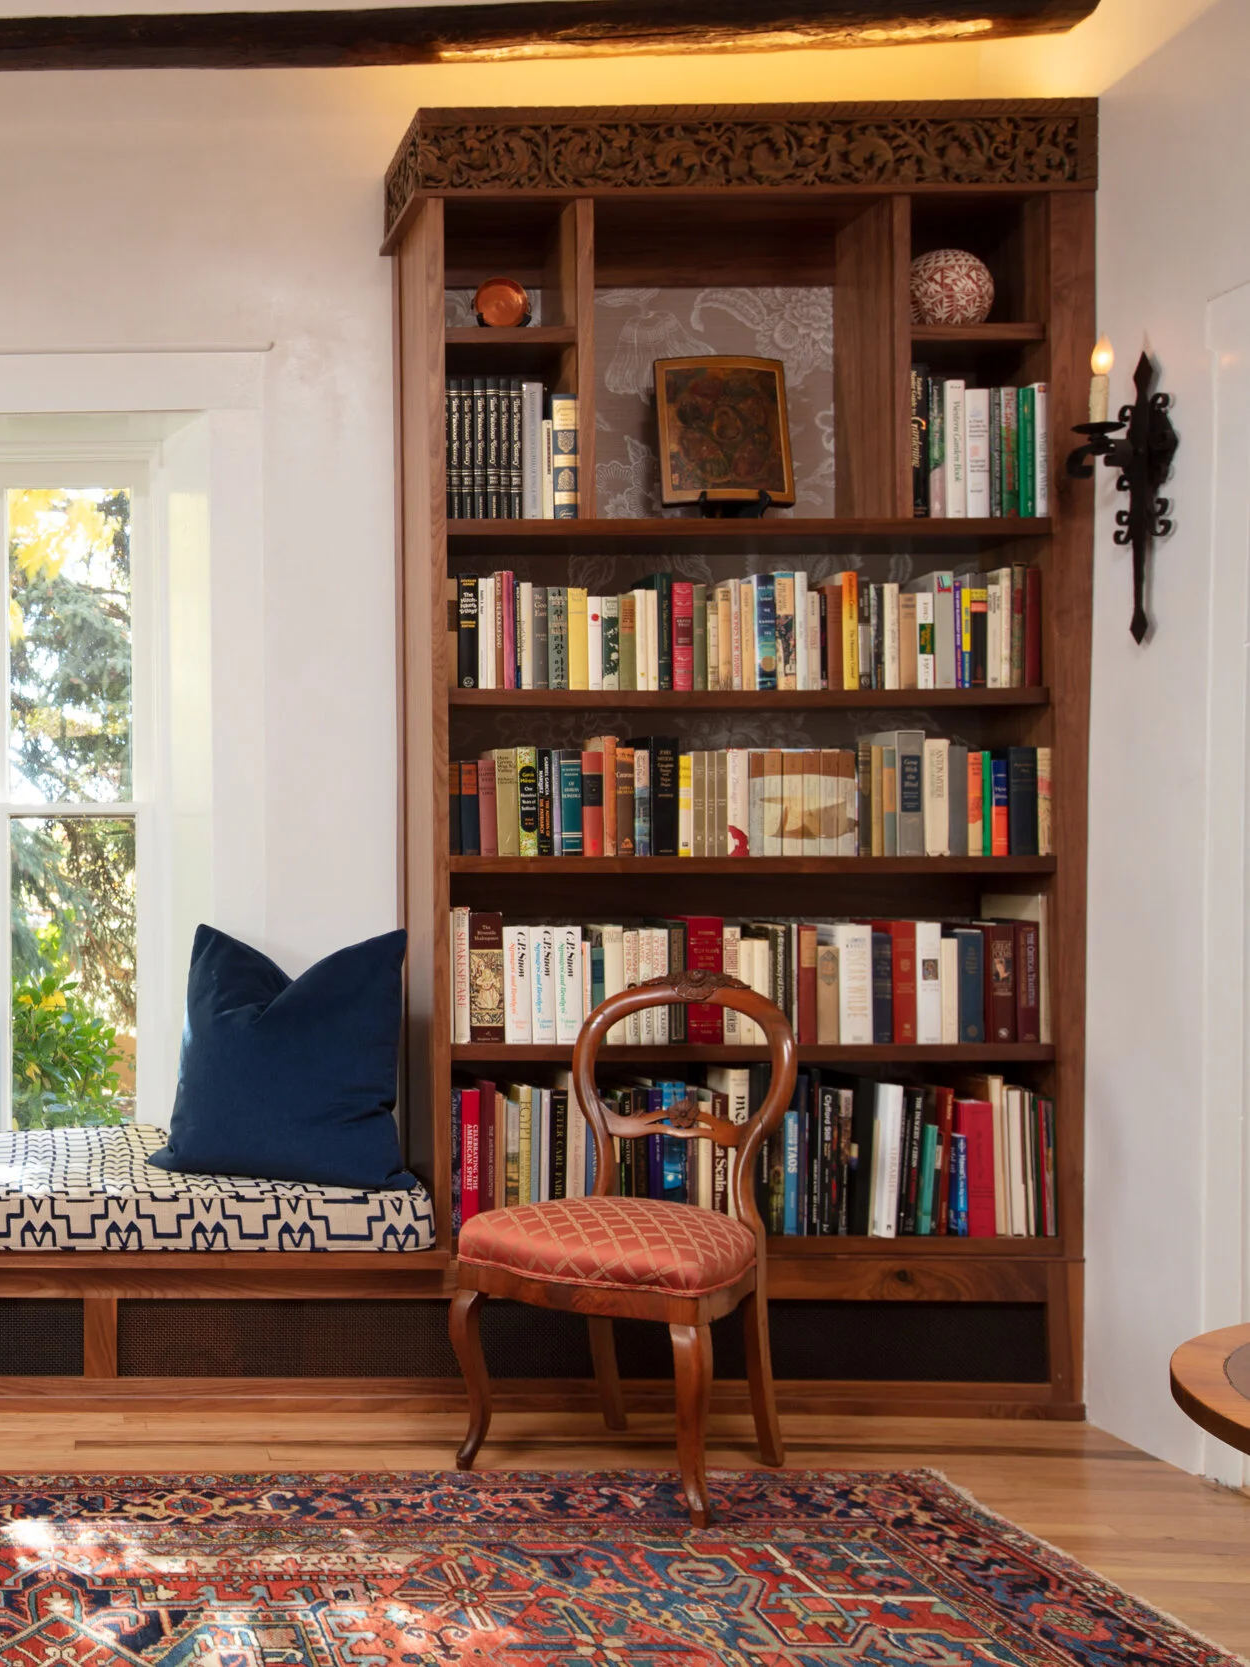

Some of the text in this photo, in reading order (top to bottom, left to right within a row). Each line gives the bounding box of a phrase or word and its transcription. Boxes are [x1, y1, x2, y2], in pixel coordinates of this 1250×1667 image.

[1005, 391, 1013, 410] The
[451, 441, 459, 467] Century
[464, 441, 472, 467] Century
[512, 441, 520, 467] Century
[911, 416, 926, 468] Gardening
[952, 433, 960, 462] Garden
[954, 464, 962, 482] Book
[456, 931, 466, 1008] SHAKESPEARE
[517, 932, 526, 979] C.P. Snow
[543, 930, 552, 978] C.P. Snow
[566, 931, 575, 978] C.P. Snow
[847, 950, 867, 980] OSCAR
[847, 985, 868, 1018] WILDE
[823, 1094, 832, 1125] Clyfford
[555, 1105, 564, 1168] PETER CARL
[787, 1146, 798, 1173] TAOS
[715, 1159, 727, 1192] Scala
